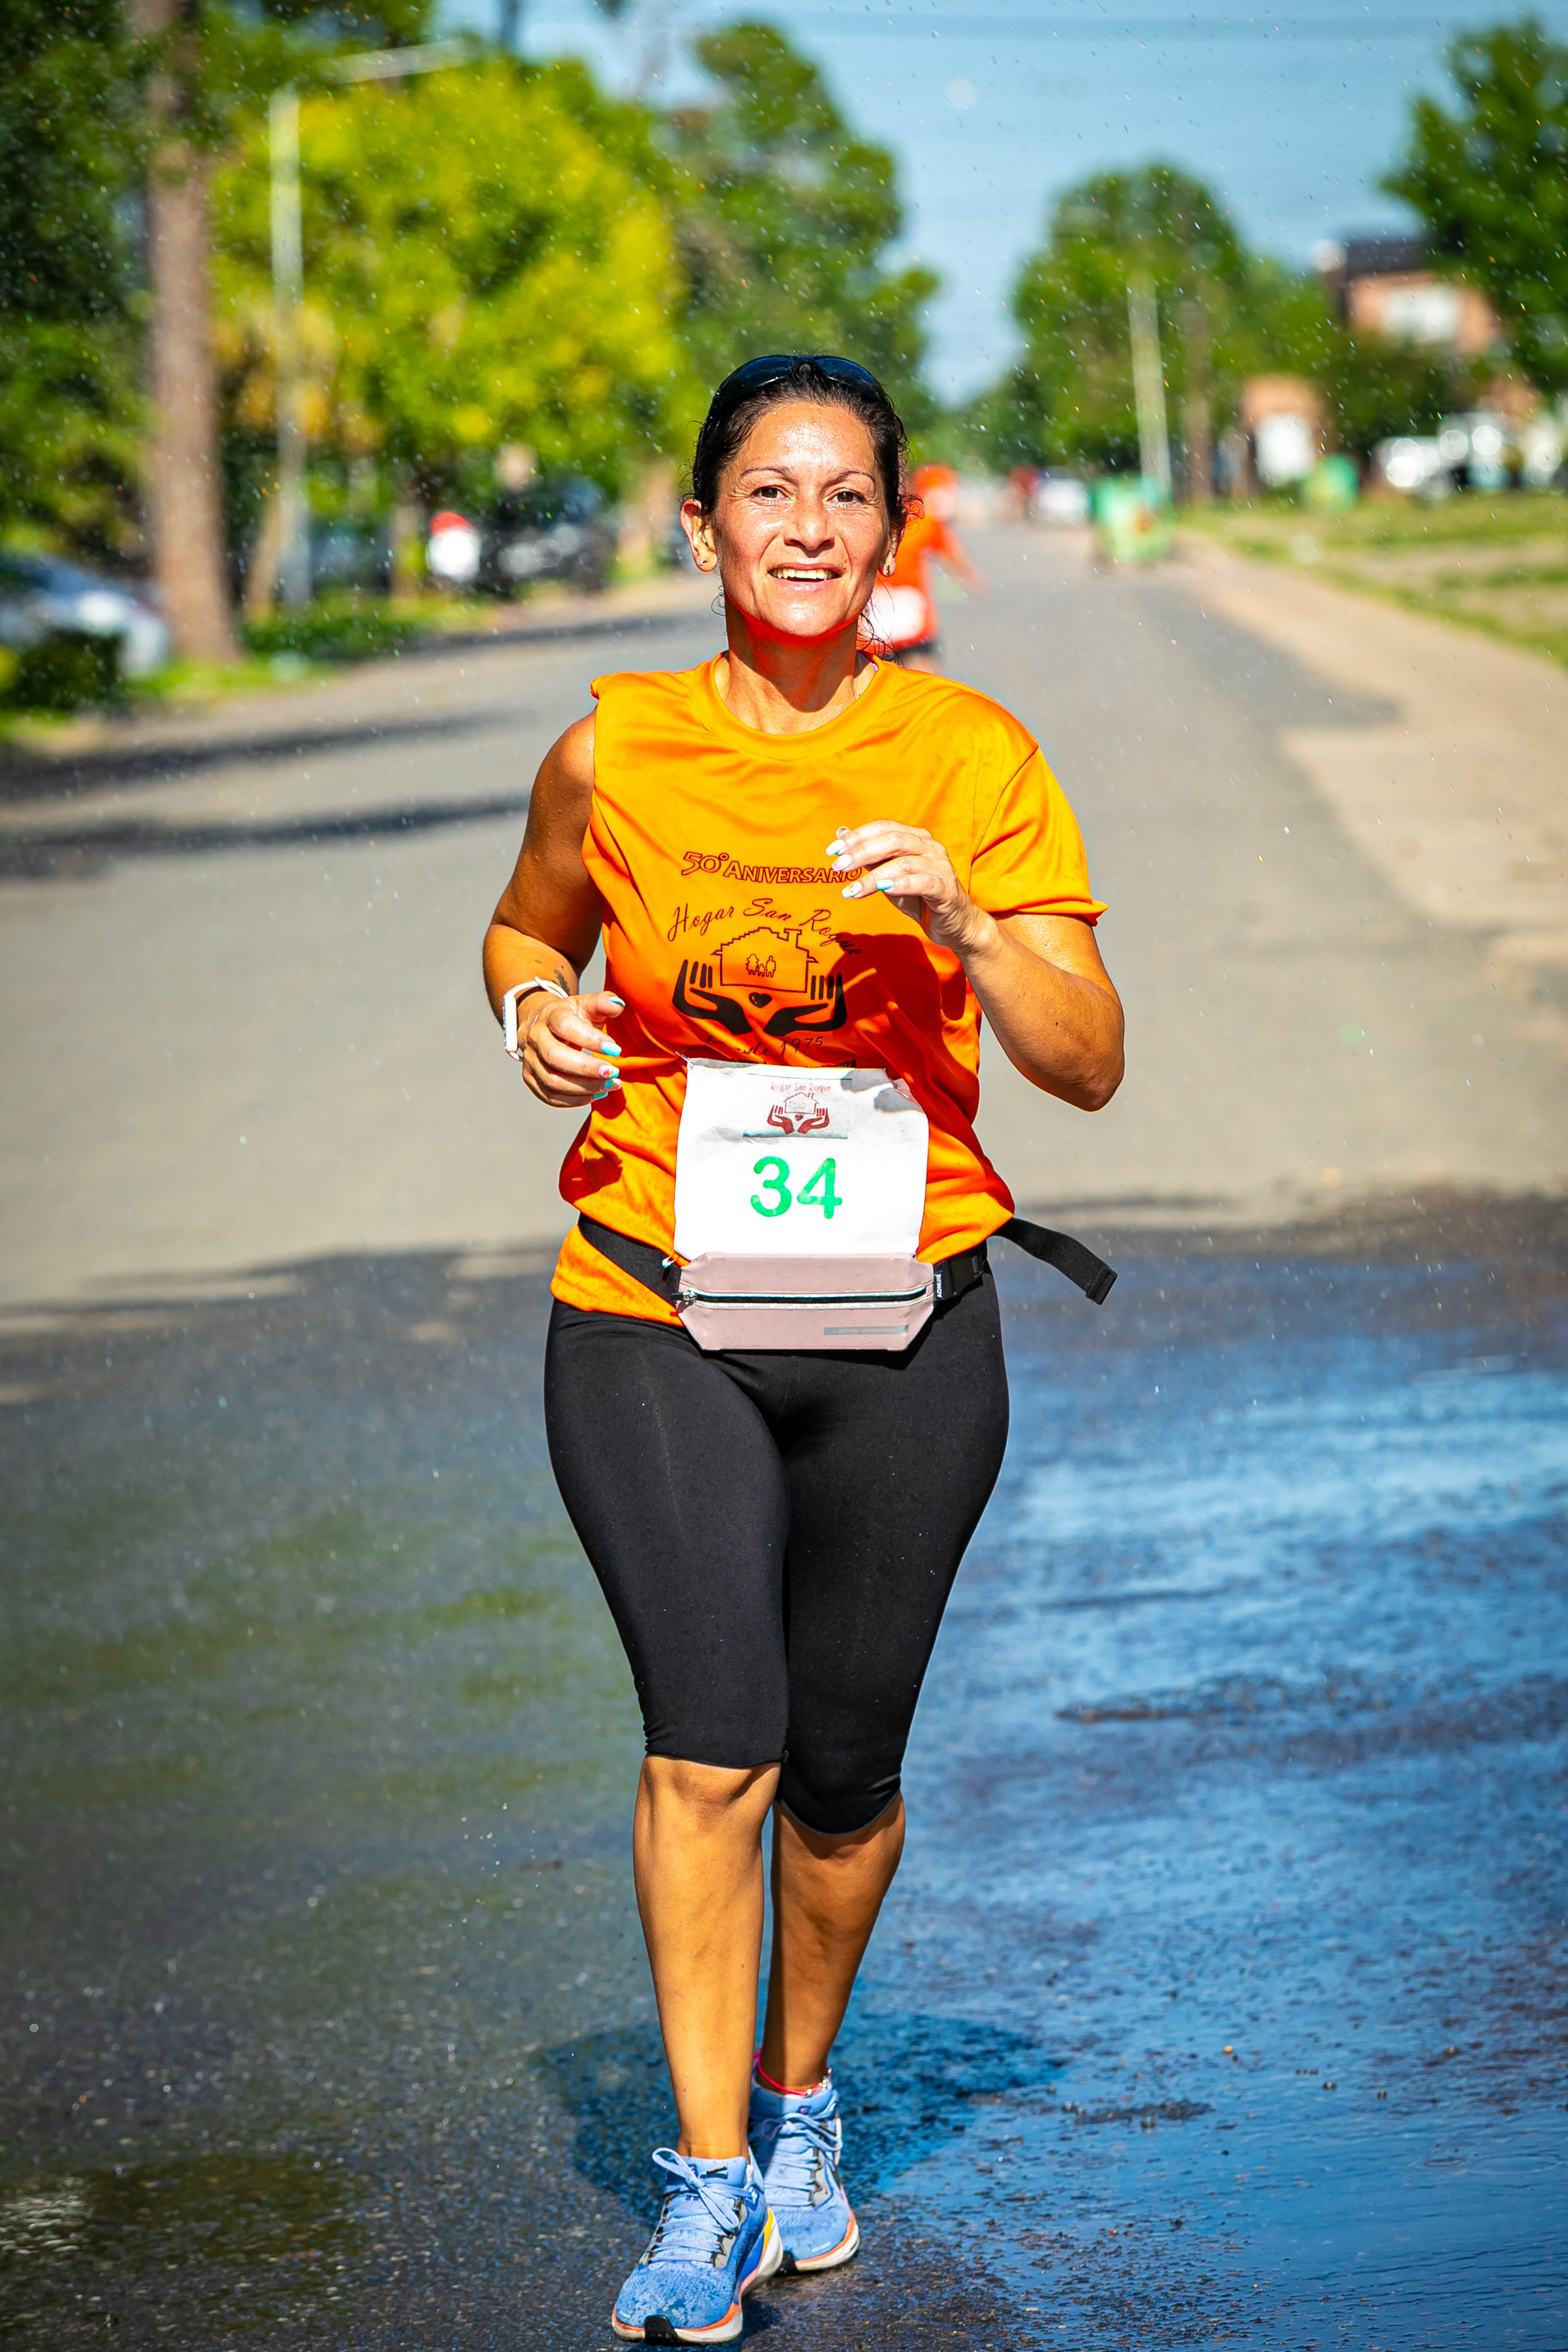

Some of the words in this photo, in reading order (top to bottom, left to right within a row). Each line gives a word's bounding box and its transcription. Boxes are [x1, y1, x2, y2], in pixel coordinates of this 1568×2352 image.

[723, 860, 863, 883] ANIVERSARIO
[668, 902, 735, 942] Hogar
[743, 898, 792, 922] San
[798, 909, 862, 956] Roque
[780, 1036, 825, 1058] 1975
[770, 1081, 791, 1092] Hogar
[794, 1083, 807, 1092] San
[808, 1083, 831, 1093] Roque
[750, 1156, 843, 1219] 34
